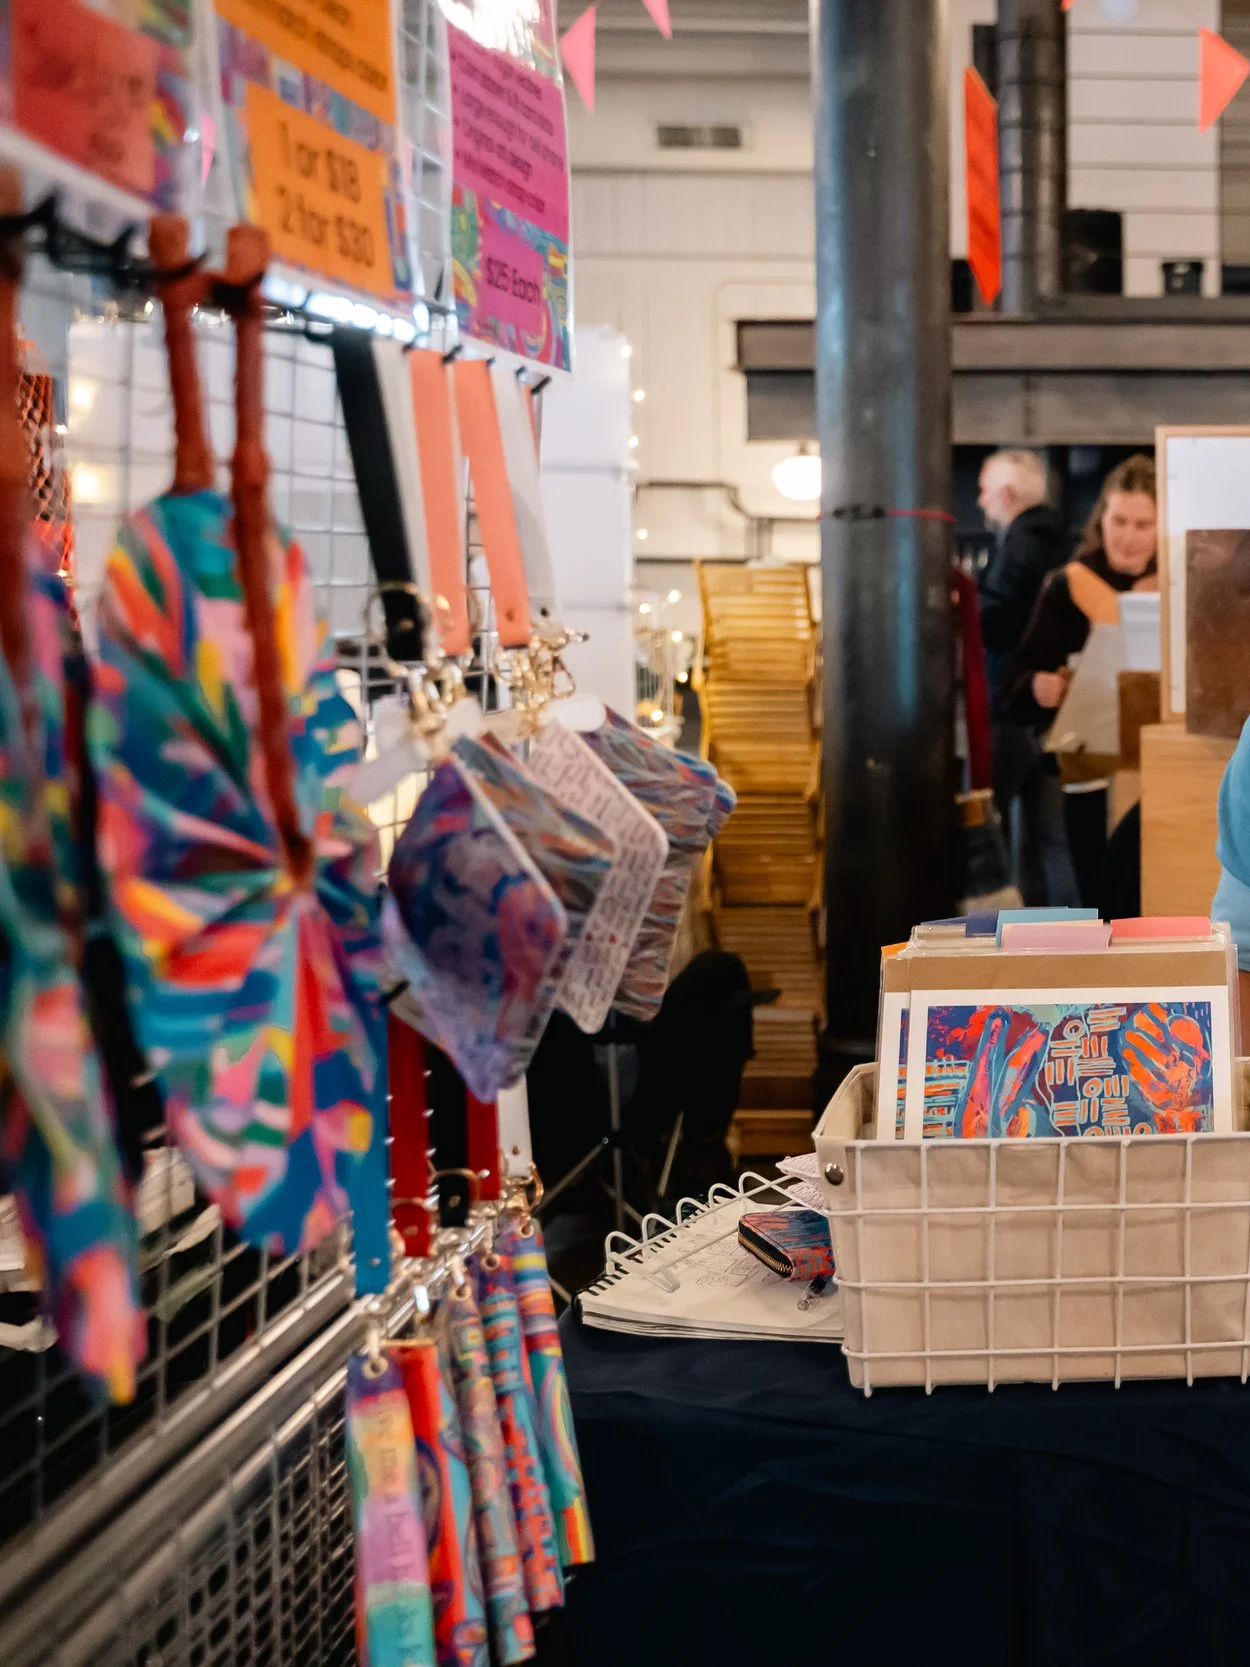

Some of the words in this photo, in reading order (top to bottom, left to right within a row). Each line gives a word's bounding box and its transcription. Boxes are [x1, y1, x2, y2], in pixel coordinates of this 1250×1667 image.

[275, 185, 294, 234] 2
[486, 257, 510, 292] $25
[512, 267, 540, 306] Each
